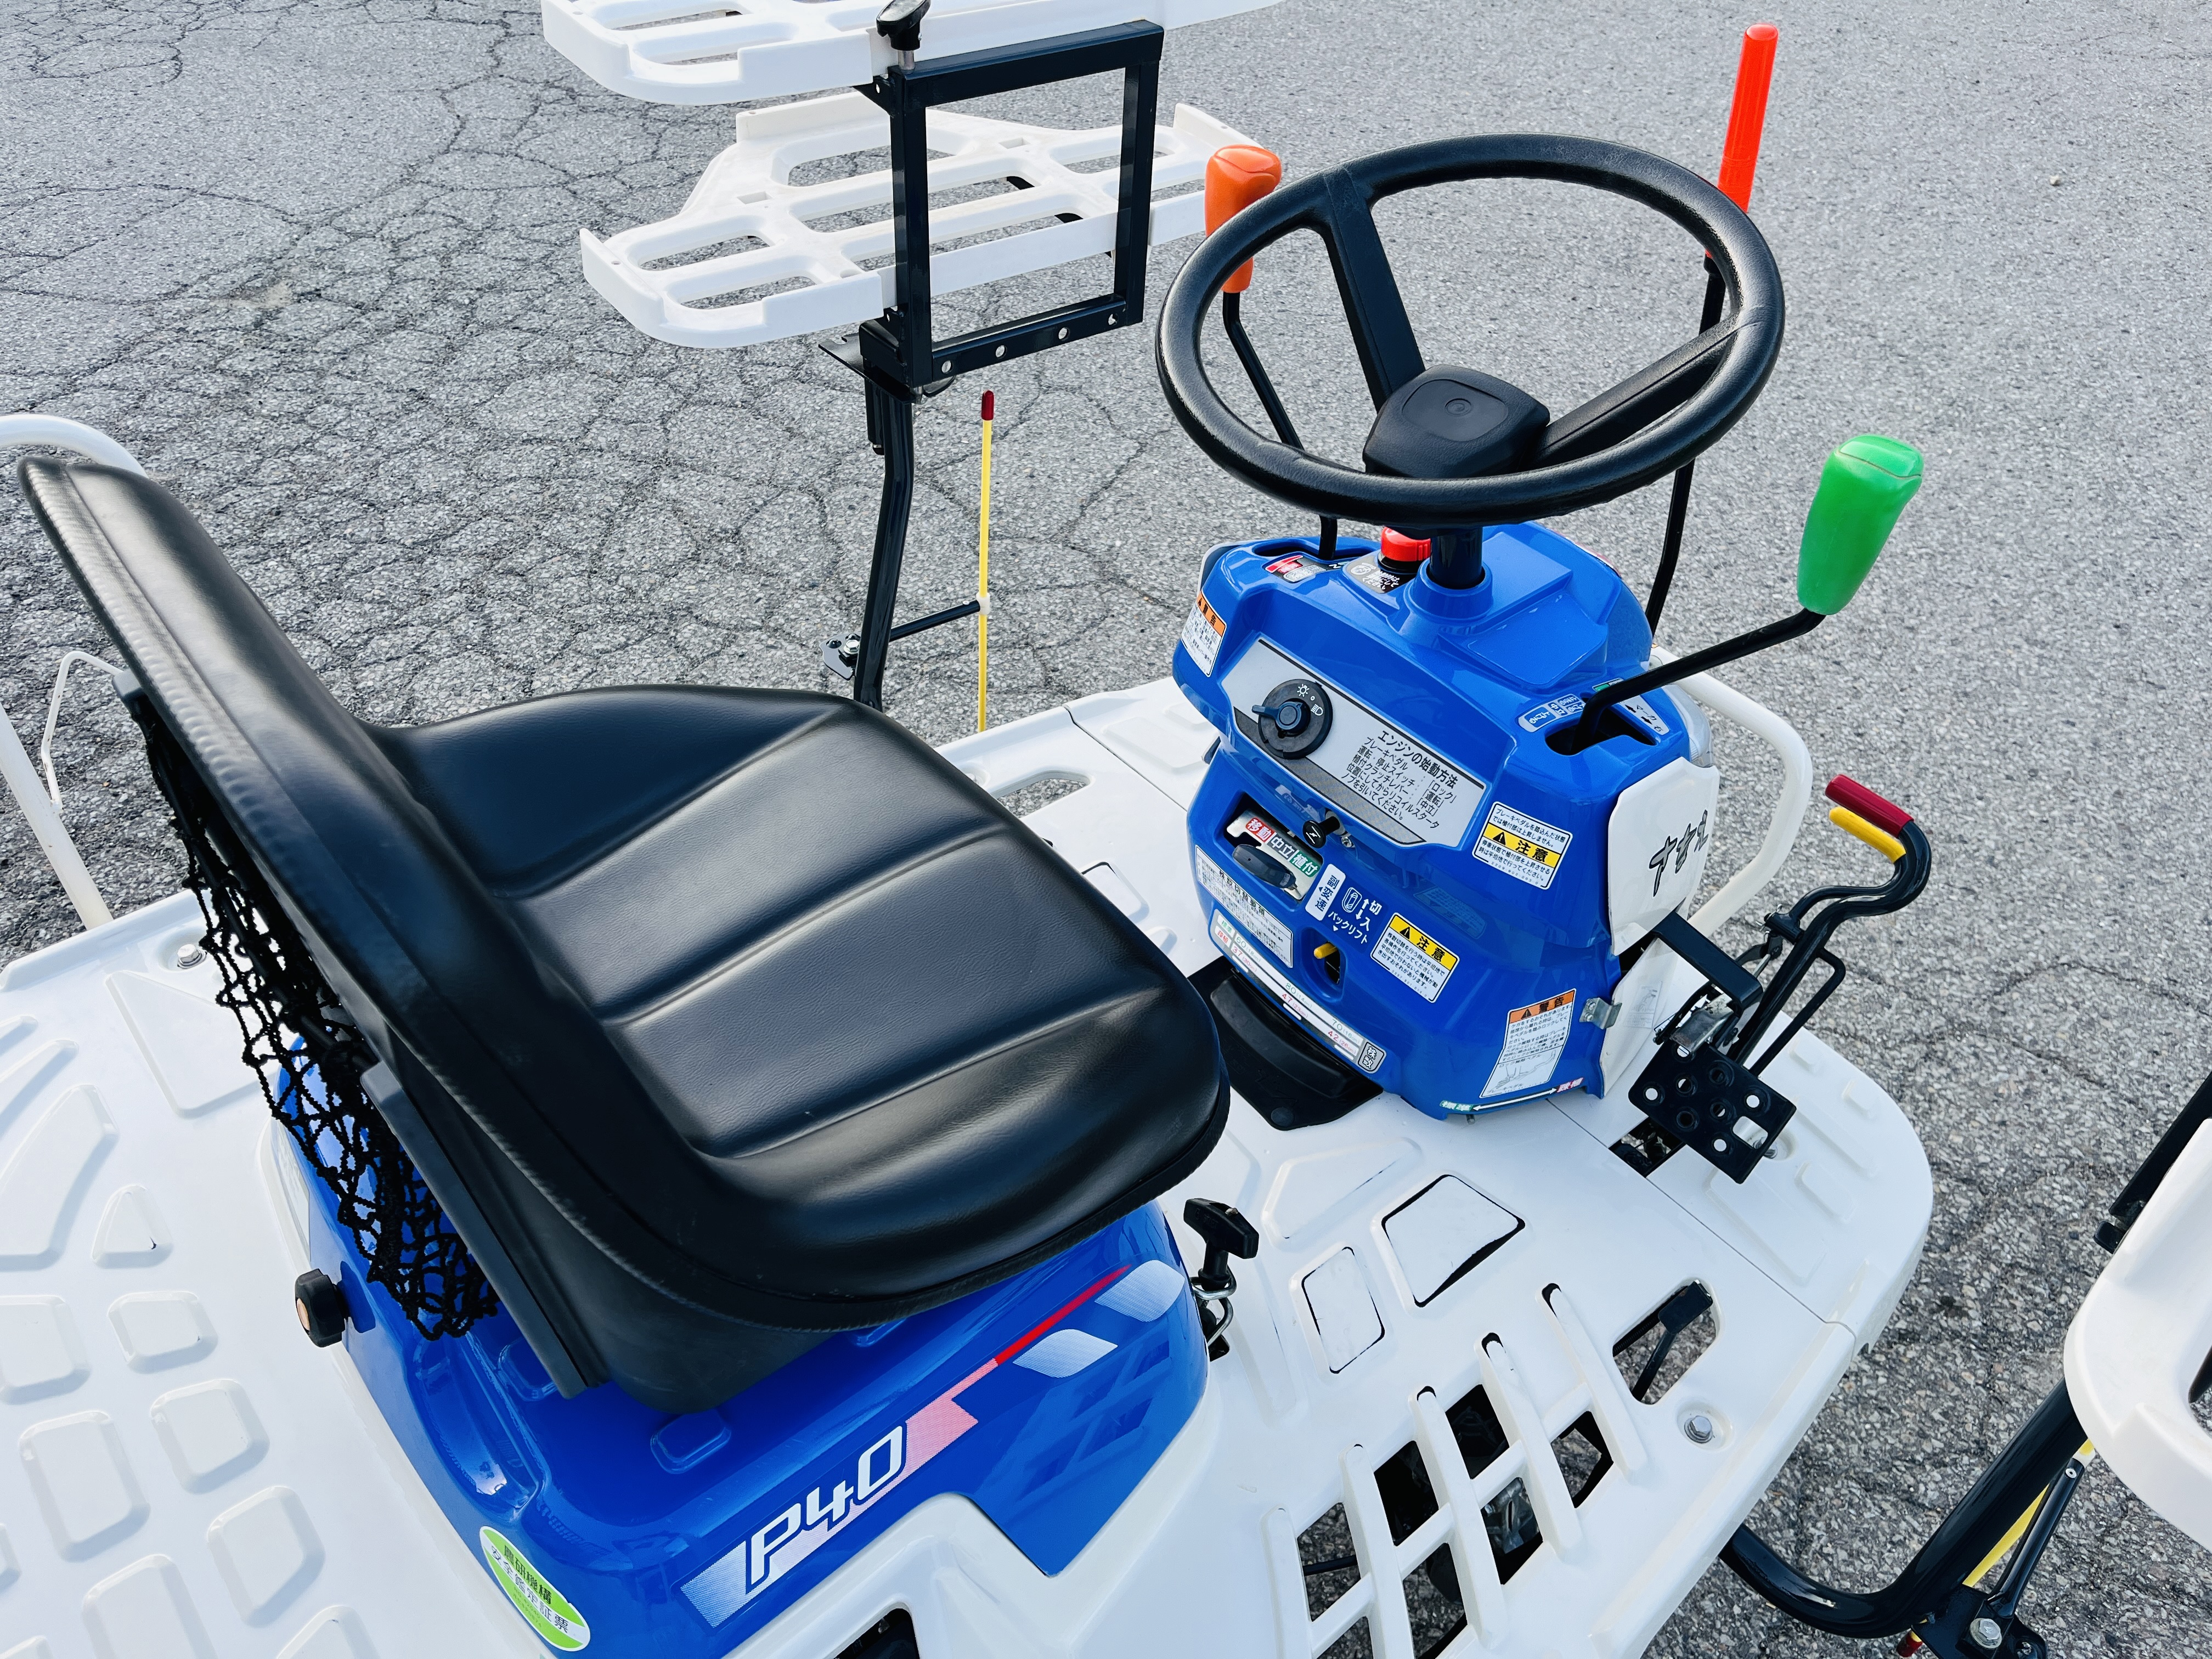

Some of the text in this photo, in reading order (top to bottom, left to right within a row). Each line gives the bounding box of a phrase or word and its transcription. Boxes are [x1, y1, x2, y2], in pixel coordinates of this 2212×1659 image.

[1528, 710, 1551, 724] 上げる
[1364, 737, 1408, 770] ブレーキペダル
[1378, 730, 1458, 789] エンジンの始動方法
[1352, 754, 1409, 795] 植付クラッチレバー
[1341, 774, 1403, 820] ノブを引いてください。
[1347, 763, 1440, 829] 位置にしてからリコイルスタータ
[1248, 819, 1318, 876] 移動 中立 植付
[1515, 840, 1548, 862] 注意
[1314, 875, 1340, 912] 副変速
[1369, 900, 1383, 915] 切
[1328, 911, 1368, 944] バックリフト
[1360, 917, 1371, 932] 入
[1417, 936, 1445, 962] 注意
[1362, 1046, 1377, 1069] 株数
[751, 1425, 903, 1585] P40
[491, 1545, 568, 1634] 安全鑑定証票
